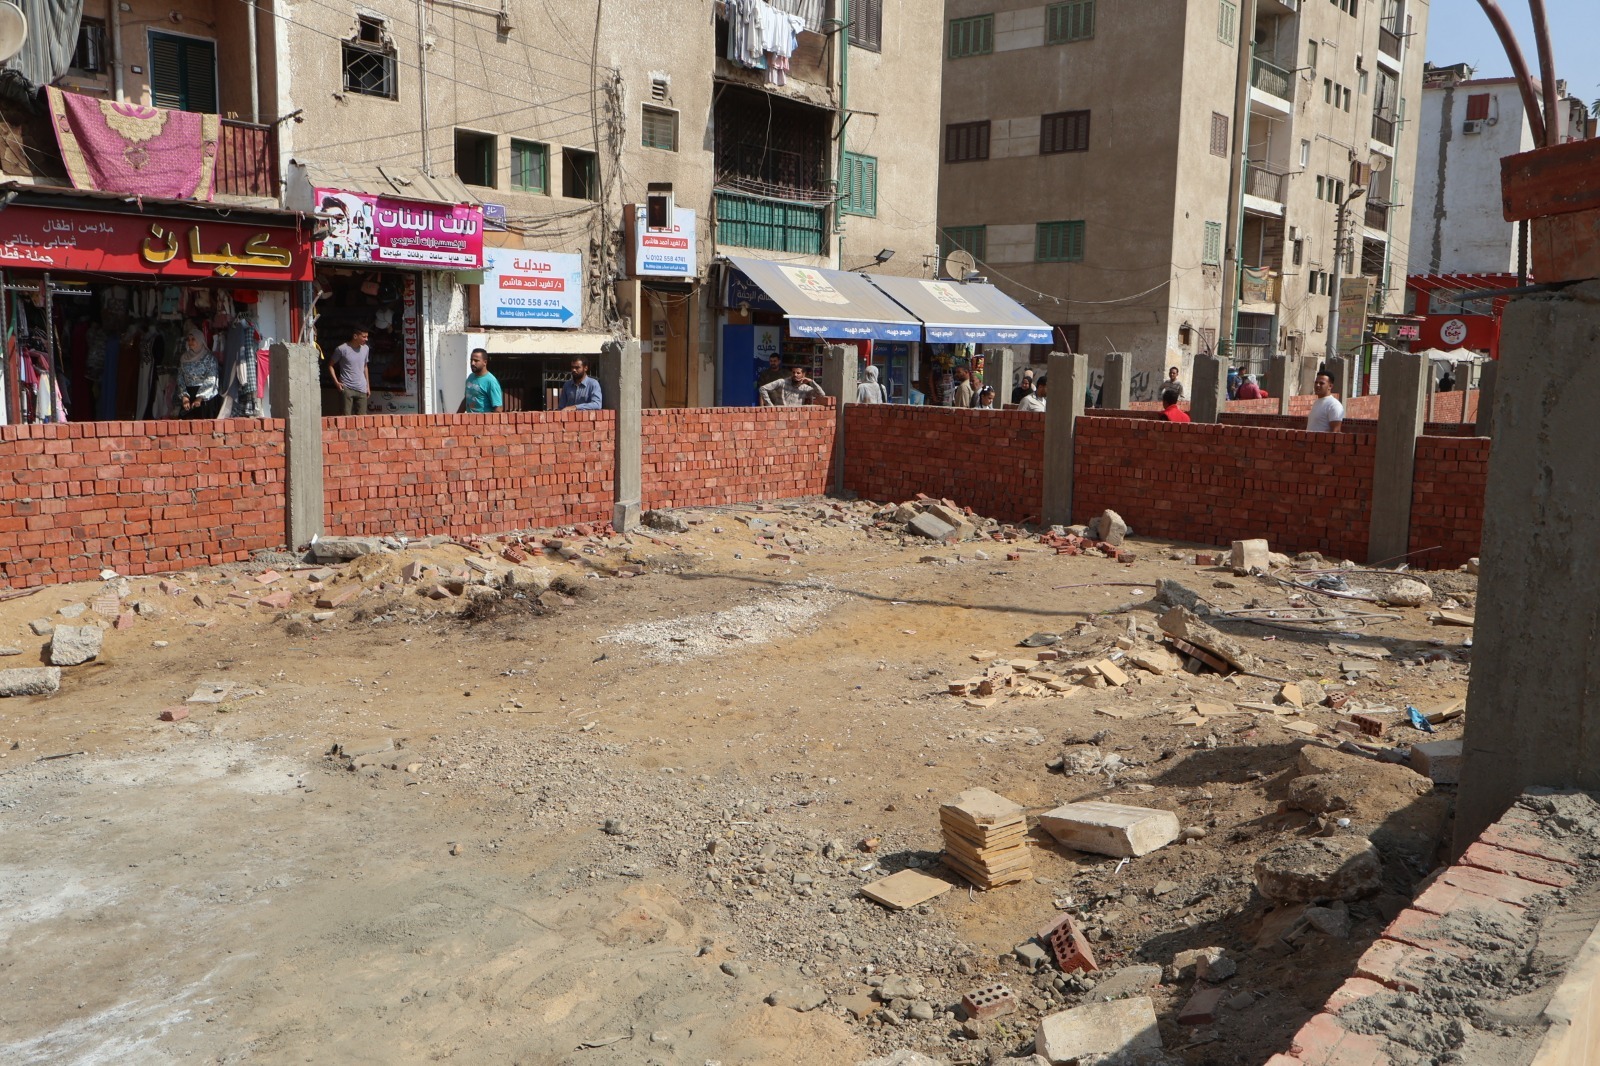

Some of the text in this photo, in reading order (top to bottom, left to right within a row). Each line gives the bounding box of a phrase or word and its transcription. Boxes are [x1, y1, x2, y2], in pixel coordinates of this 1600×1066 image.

[42, 219, 114, 233] ملابس أطفال
[378, 207, 477, 236] ست البنات
[143, 222, 293, 277] كيان
[513, 258, 552, 273] صيدلية
[502, 277, 523, 287] هاشم
[523, 278, 538, 287] أحمد
[538, 280, 554, 288] تغريد
[507, 297, 560, 307] 0102 558 4741
